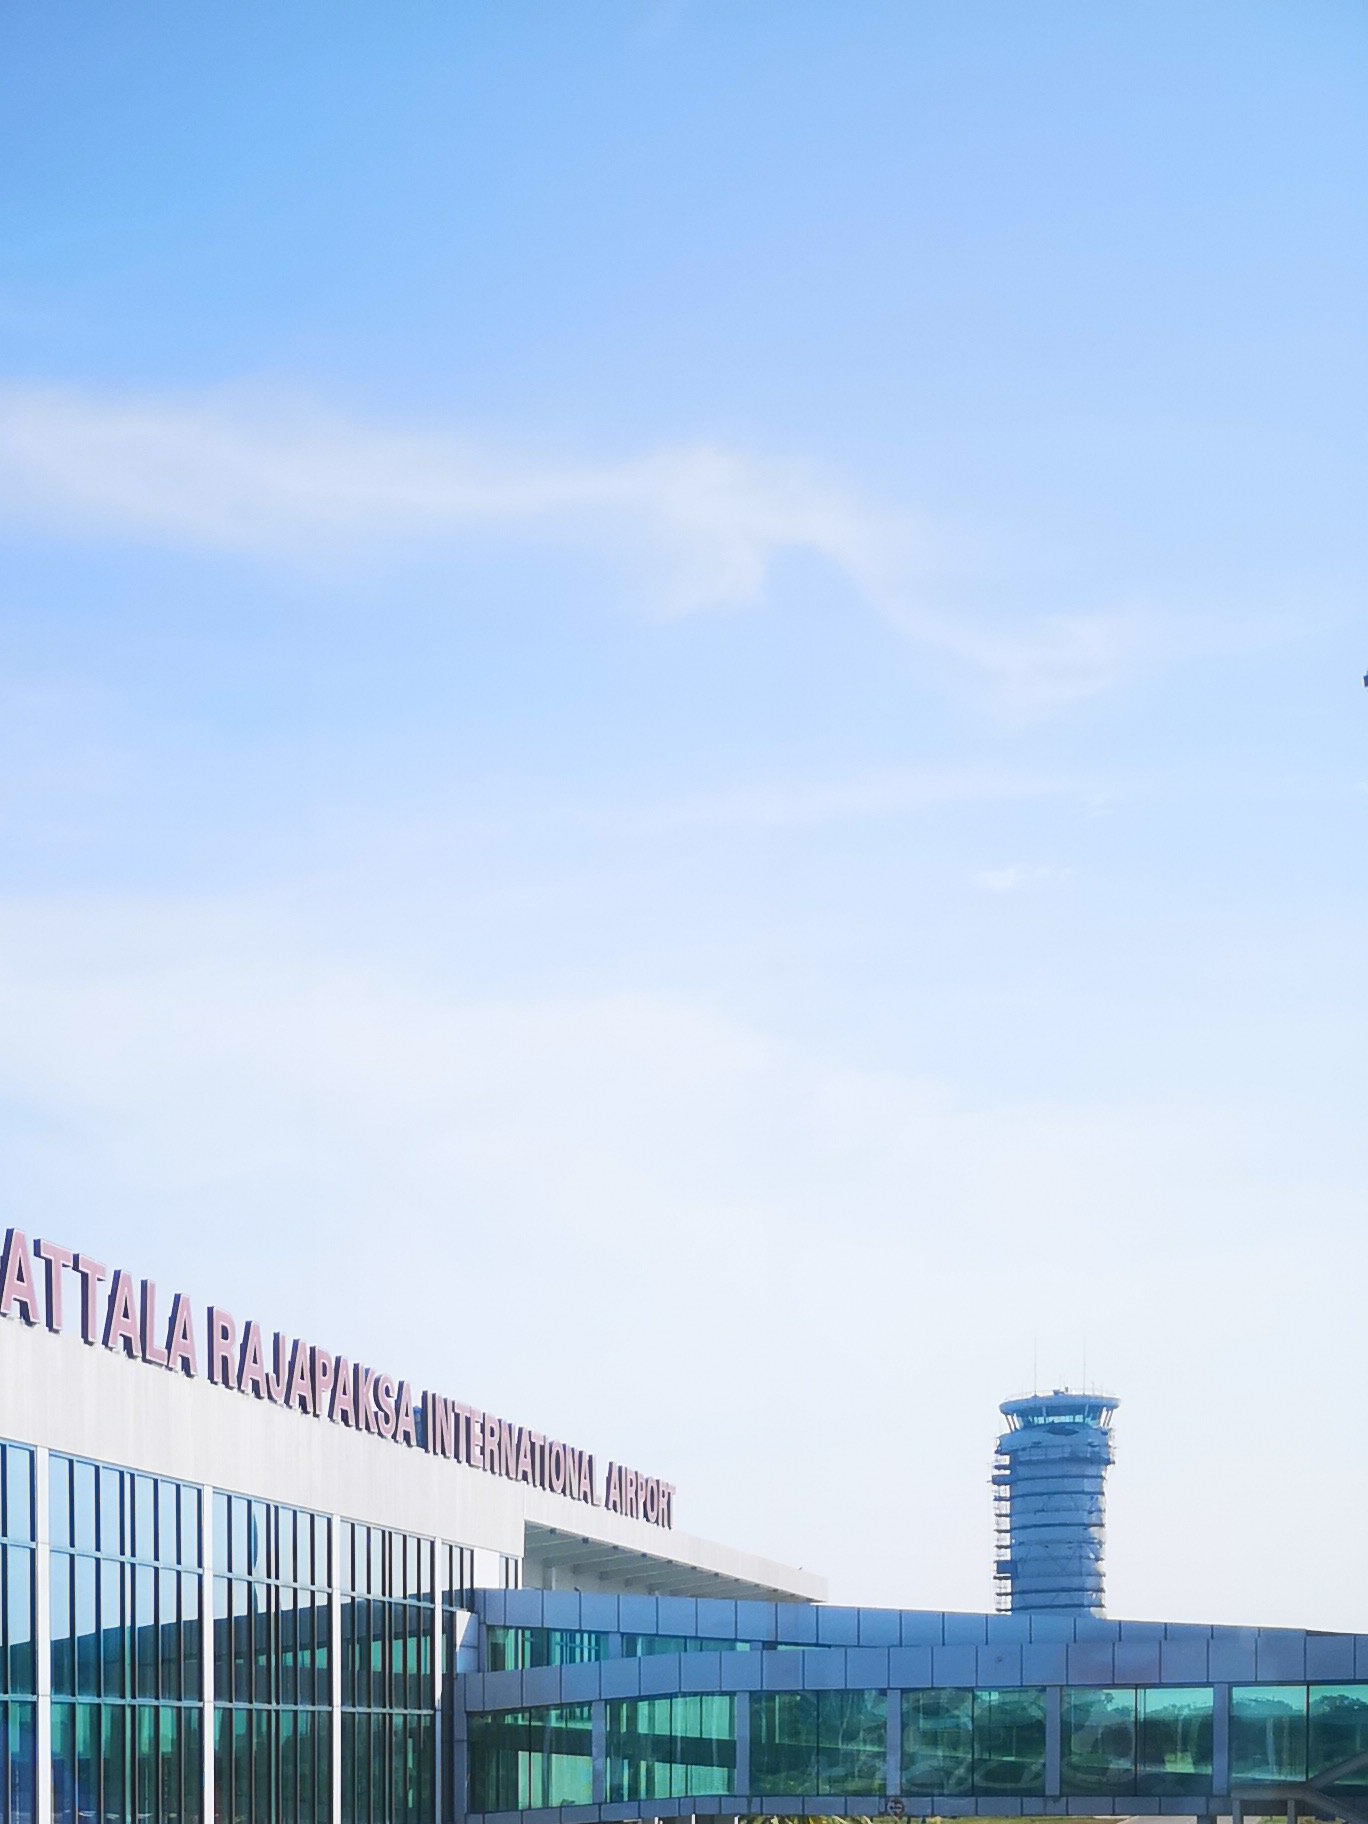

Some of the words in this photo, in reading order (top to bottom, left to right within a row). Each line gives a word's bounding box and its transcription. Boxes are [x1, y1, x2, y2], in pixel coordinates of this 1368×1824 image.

[206, 1304, 418, 1447] RAJAPAKSA
[420, 1389, 604, 1508] INTERNATIONAL
[604, 1460, 676, 1530] AIRPORT
